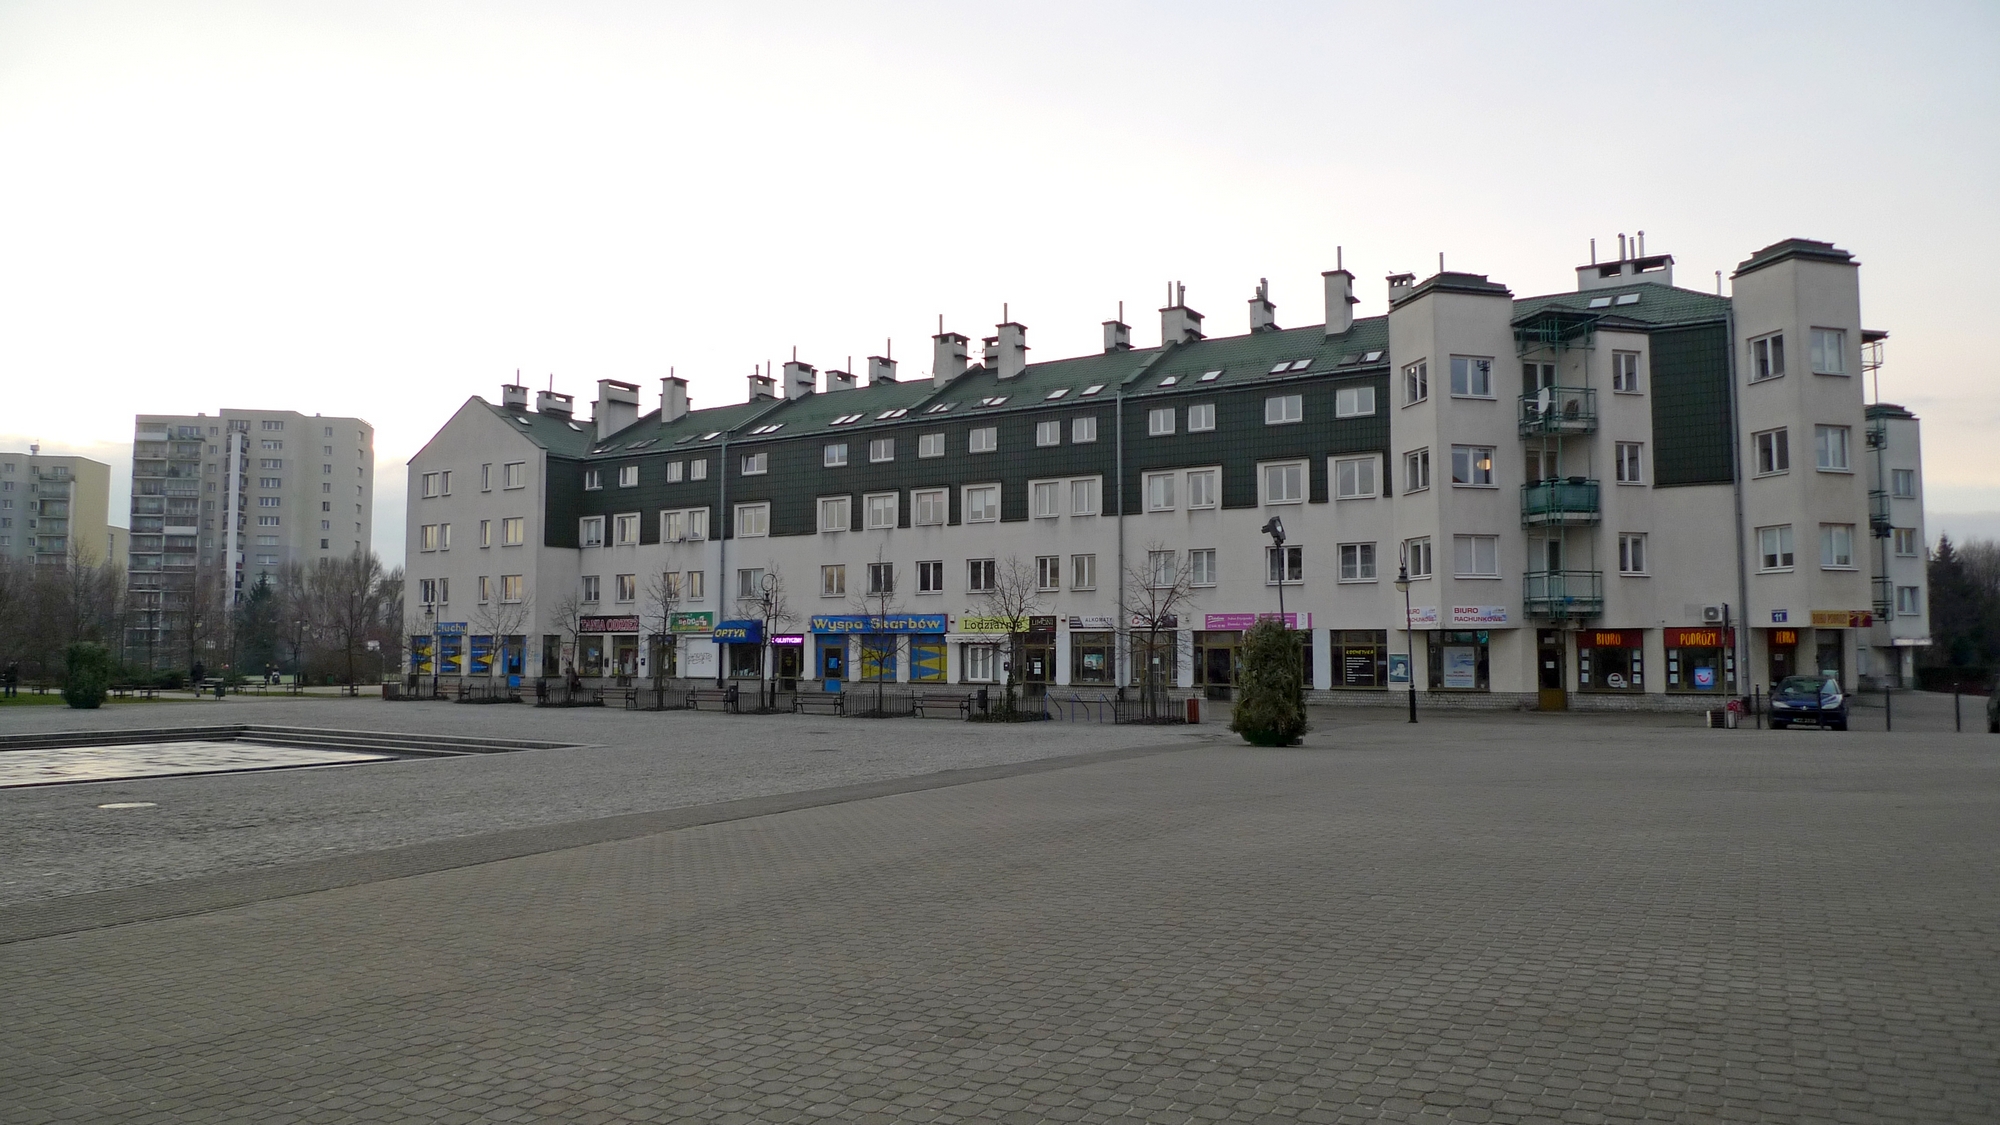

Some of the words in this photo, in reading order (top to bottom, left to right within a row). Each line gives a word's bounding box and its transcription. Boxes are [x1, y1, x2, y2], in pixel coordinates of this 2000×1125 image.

[1774, 613, 1783, 622] 11
[581, 618, 606, 631] TANIA
[812, 618, 863, 631] Wyspa
[870, 617, 940, 629] Skarbów
[964, 619, 1023, 630] Lodziarne
[714, 629, 746, 638] OPTYK
[1596, 633, 1621, 645] BIURO
[1680, 630, 1716, 646] PODRÓŻY
